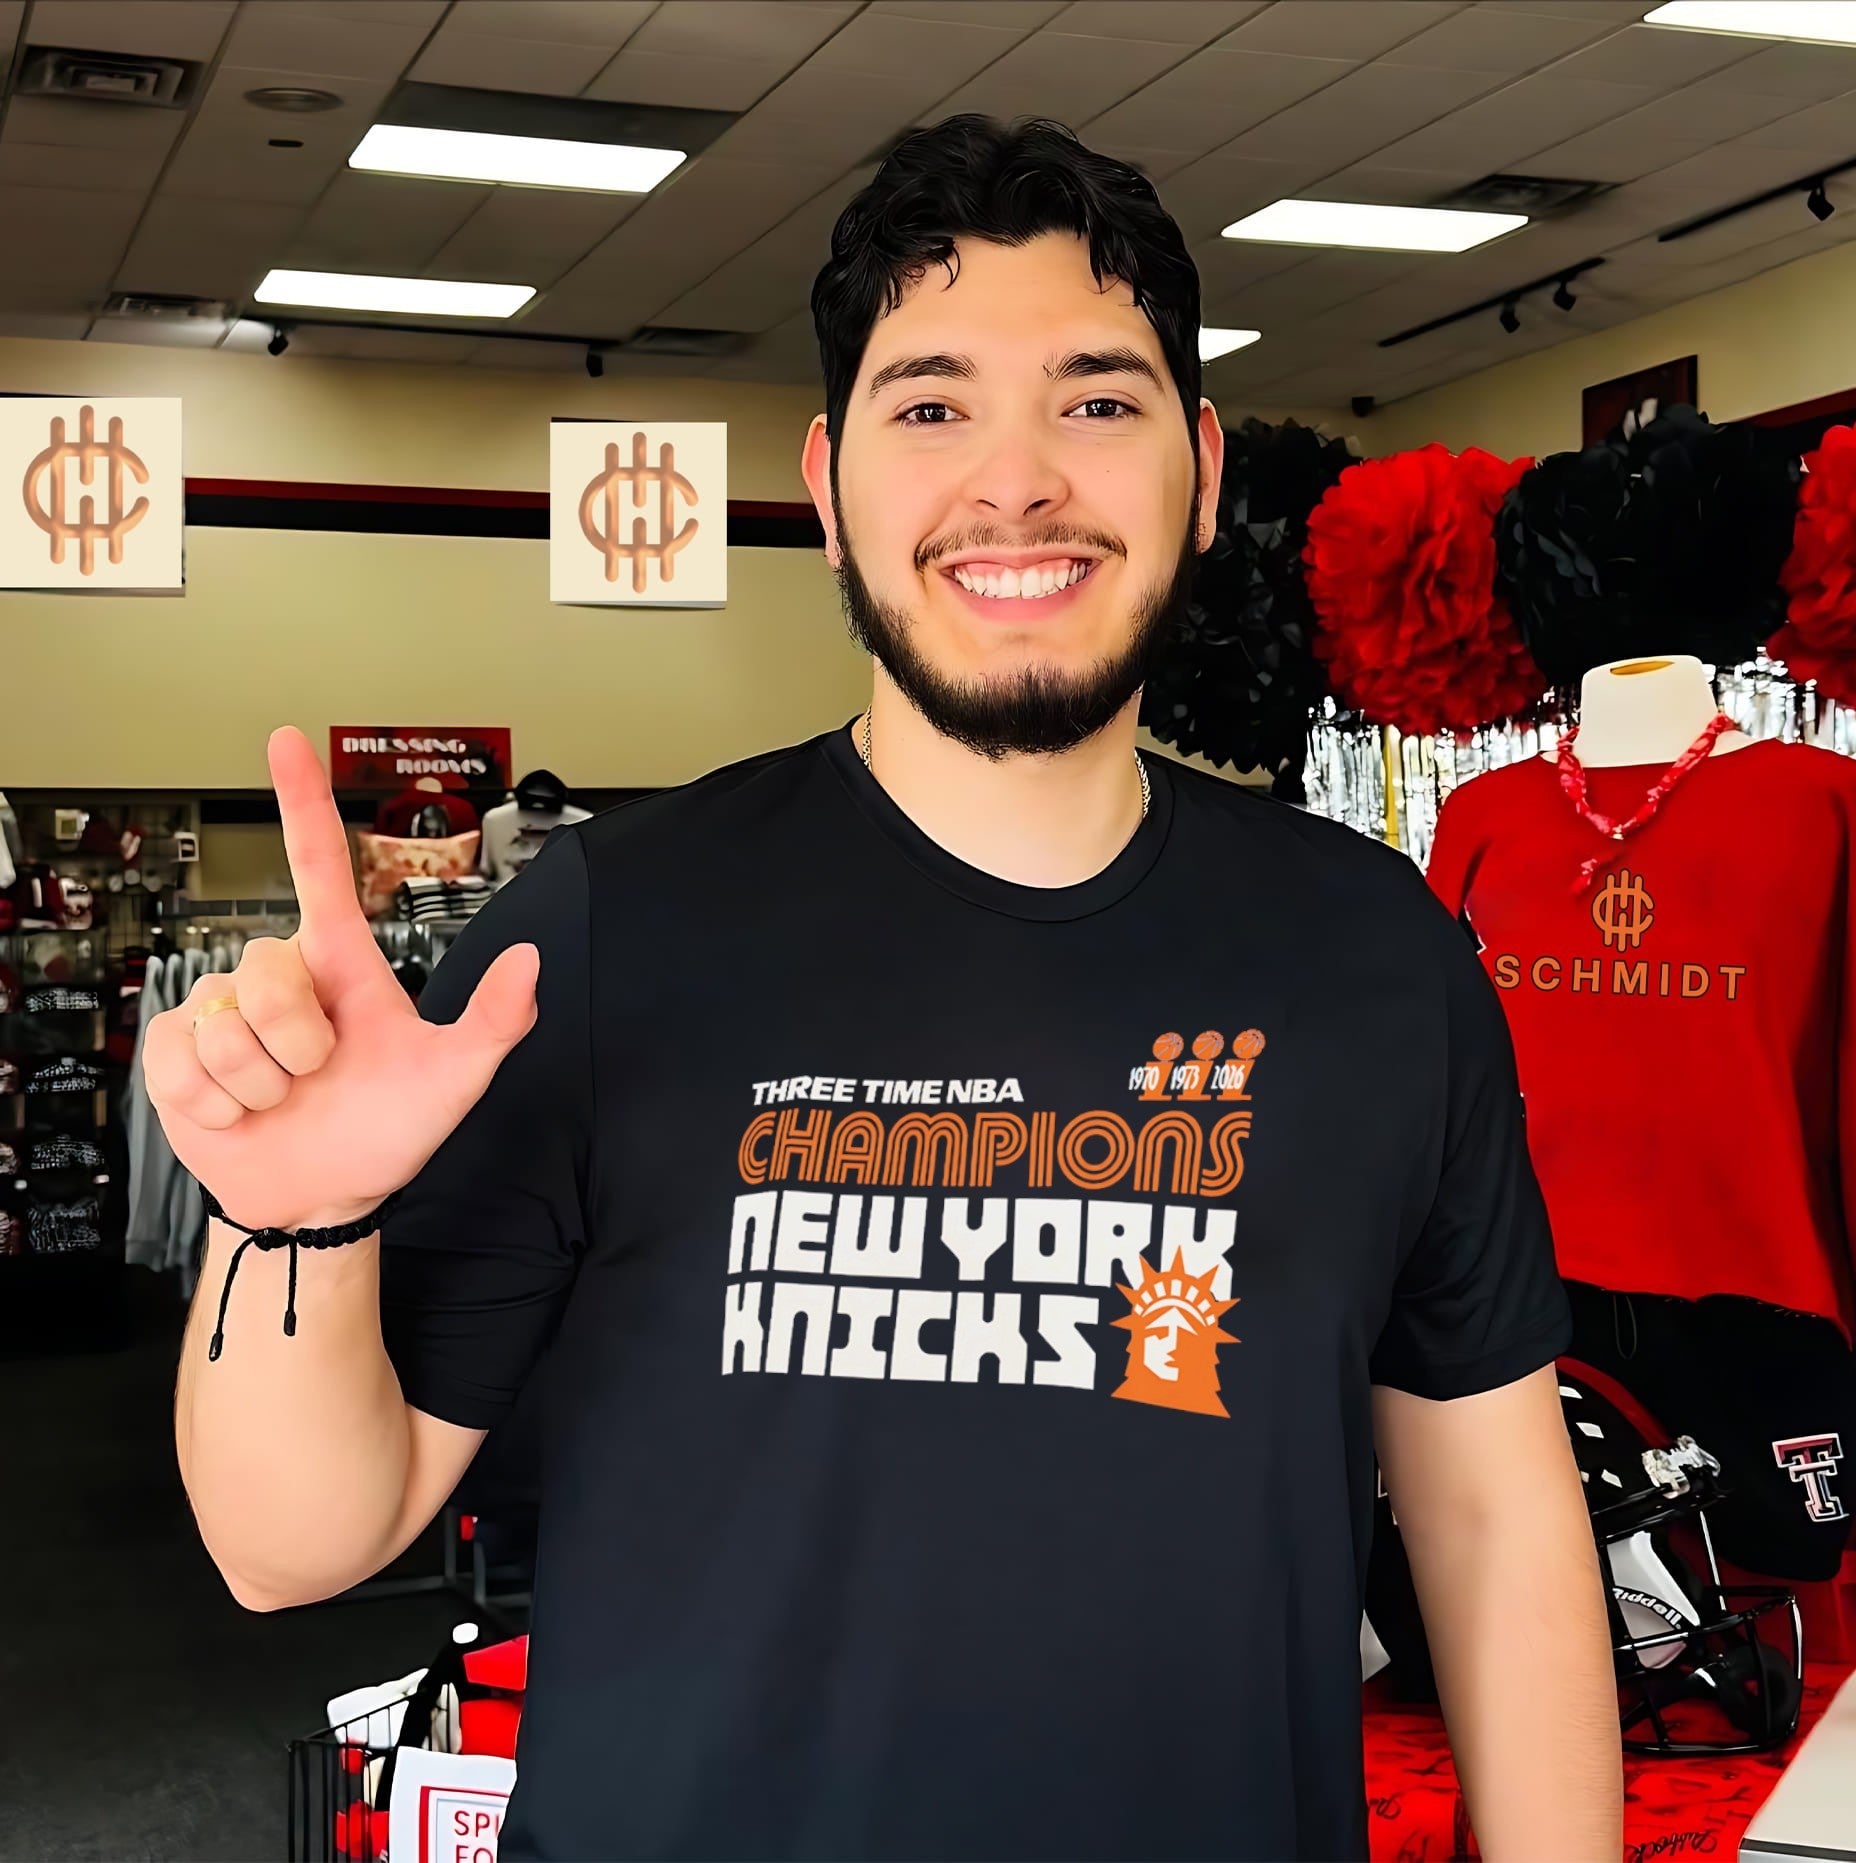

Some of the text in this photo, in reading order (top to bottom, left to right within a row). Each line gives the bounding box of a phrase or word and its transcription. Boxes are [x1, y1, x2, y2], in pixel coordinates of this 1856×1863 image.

[396, 758, 487, 775] ROOMS
[1494, 954, 1747, 1000] SCHMIDT
[752, 1075, 1025, 1105] THREE TIME NBA
[1128, 1063, 1246, 1091] 1970 1973 2026
[738, 1108, 1253, 1197] CHAMPIONS
[727, 1190, 1238, 1303] NEW YORK
[721, 1281, 1100, 1391] KNICKS
